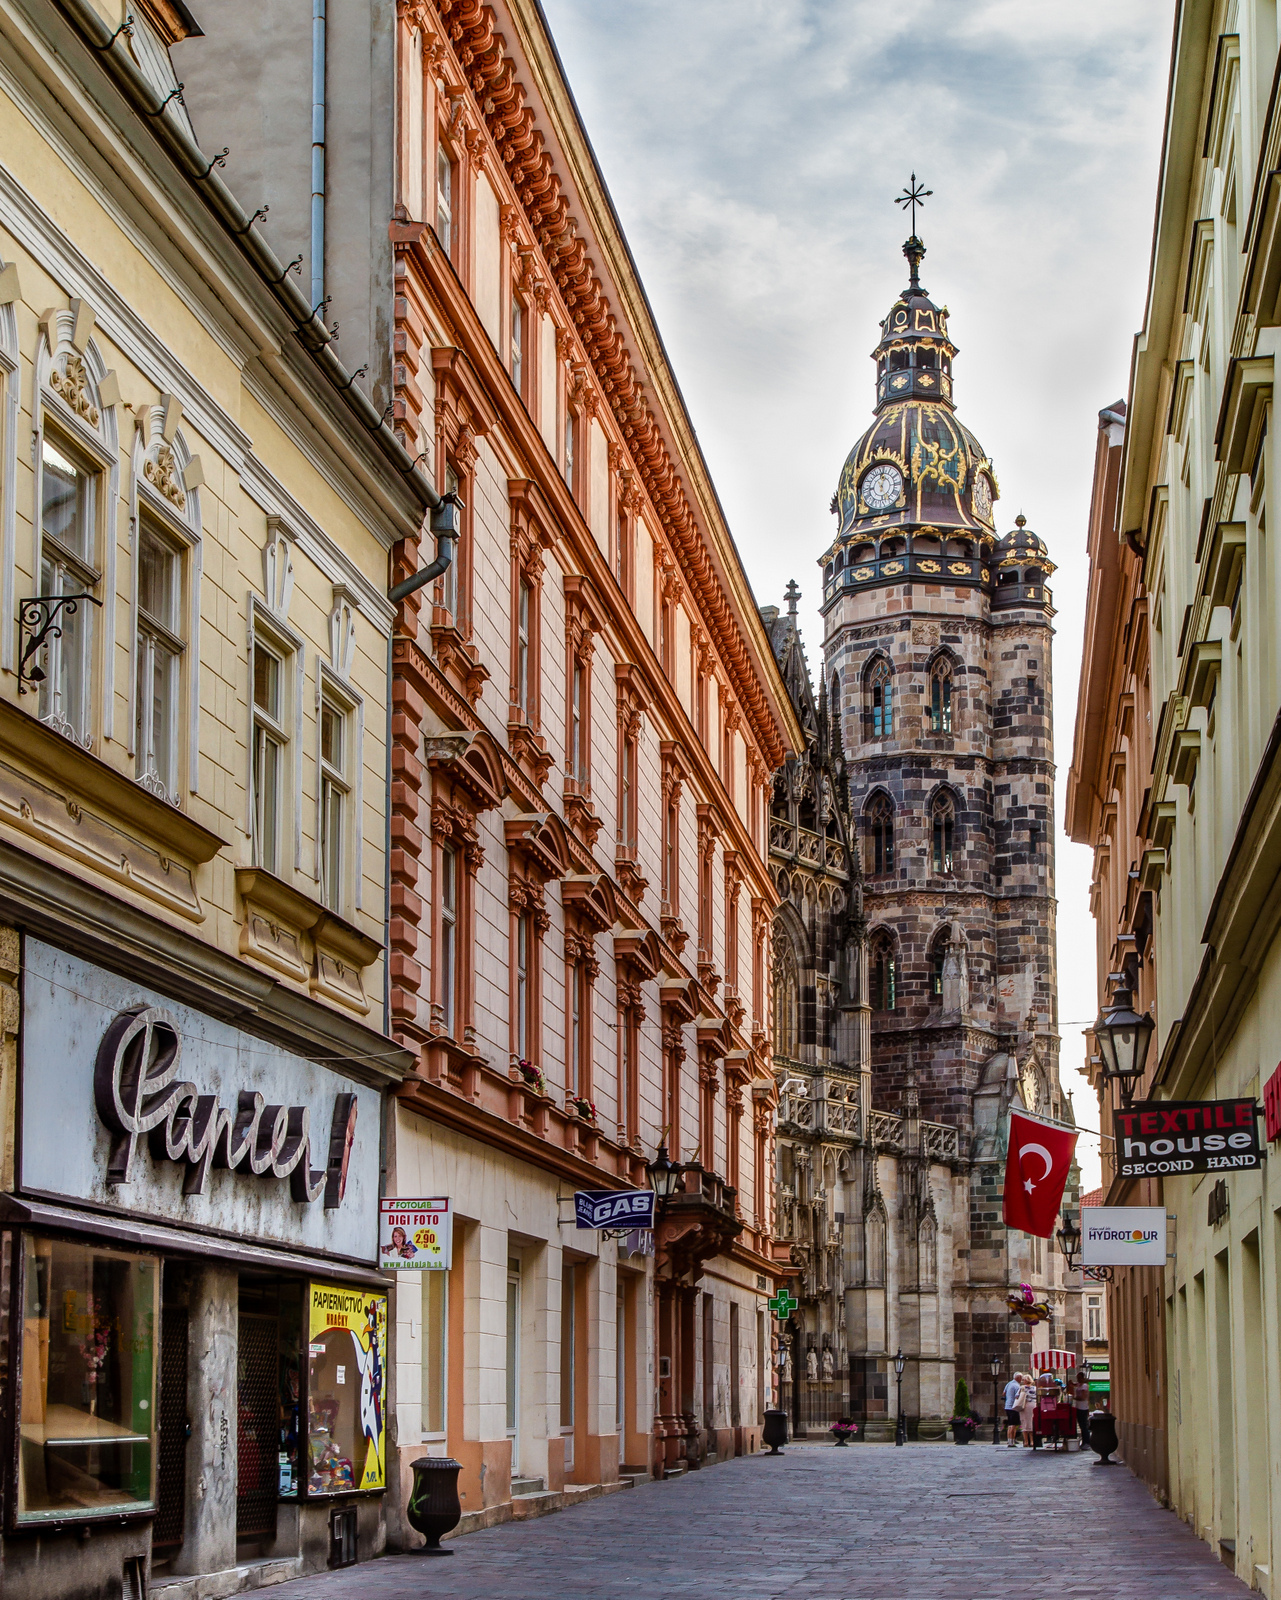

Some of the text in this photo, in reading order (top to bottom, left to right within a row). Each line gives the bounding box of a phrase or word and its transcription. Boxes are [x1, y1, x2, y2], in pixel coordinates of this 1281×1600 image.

[1118, 1104, 1253, 1136] TEXTILE
[1123, 1132, 1252, 1158] house
[1122, 1154, 1256, 1176] SECOND HAND
[396, 1201, 432, 1209] FOTOLAB
[579, 1198, 593, 1212] BLUE
[594, 1196, 650, 1222] GAS
[388, 1214, 439, 1225] DIGI FOTO
[415, 1233, 435, 1244] 2,90
[326, 1312, 348, 1327] HRAČKY
